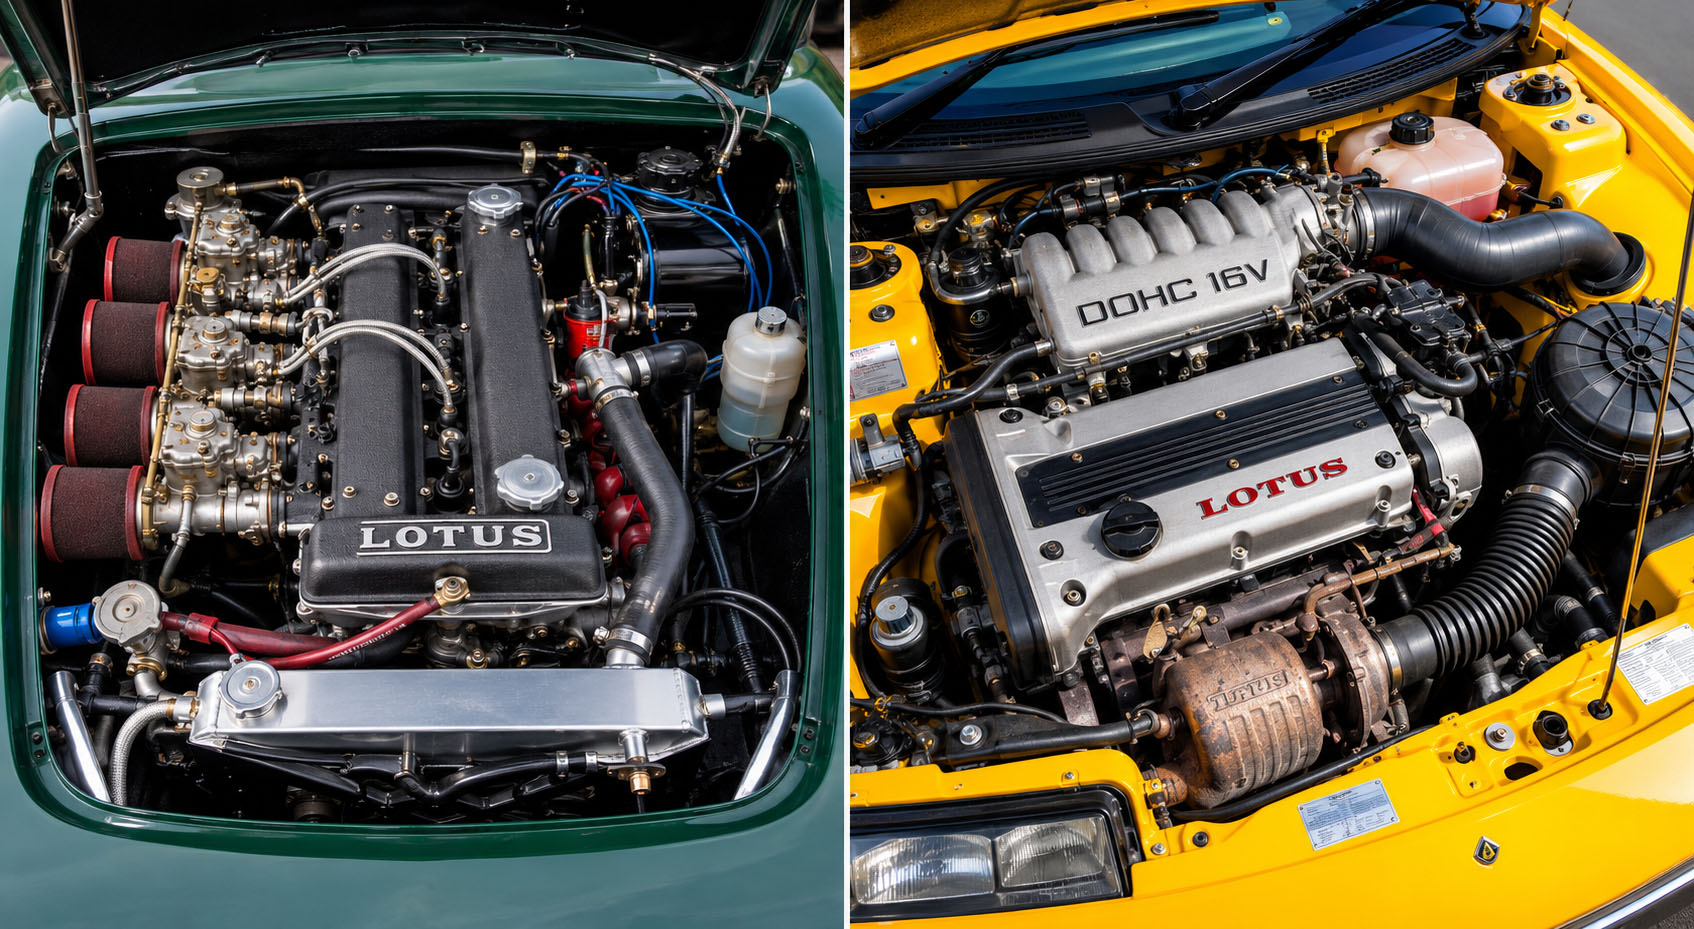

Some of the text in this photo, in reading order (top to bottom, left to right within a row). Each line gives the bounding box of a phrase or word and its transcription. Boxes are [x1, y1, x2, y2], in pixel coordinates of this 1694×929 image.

[1075, 258, 1268, 328] DOHC 16V
[1195, 457, 1348, 520] LOTUS
[359, 525, 543, 549] LOTUS
